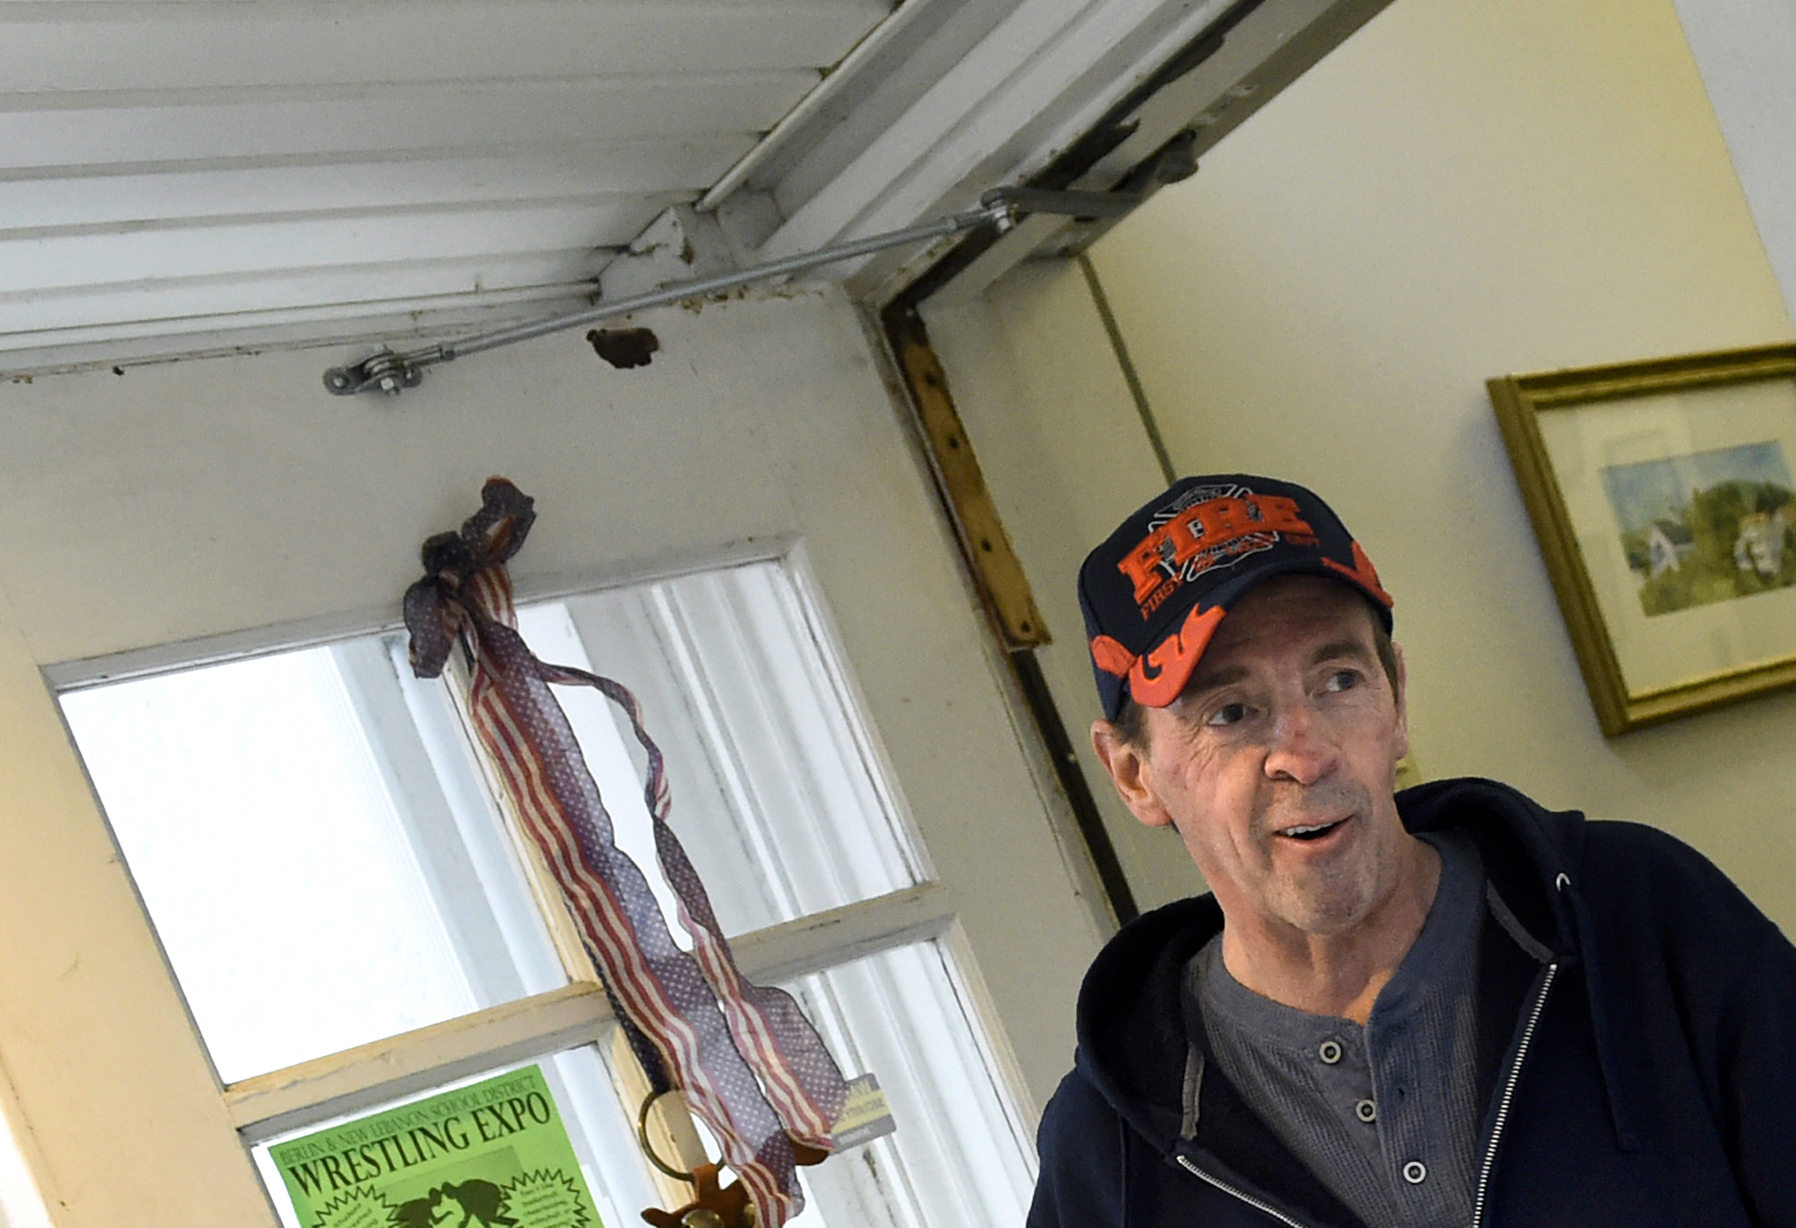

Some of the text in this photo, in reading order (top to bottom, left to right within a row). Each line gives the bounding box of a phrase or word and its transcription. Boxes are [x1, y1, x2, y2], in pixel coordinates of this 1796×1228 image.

[1117, 493, 1315, 605] FIRE
[1140, 572, 1183, 621] FIRST
[279, 1073, 537, 1166] BERLIN & NEW LEBANON SCHOOL DISTRICT
[287, 1088, 554, 1201] WRESTLING EXPO
